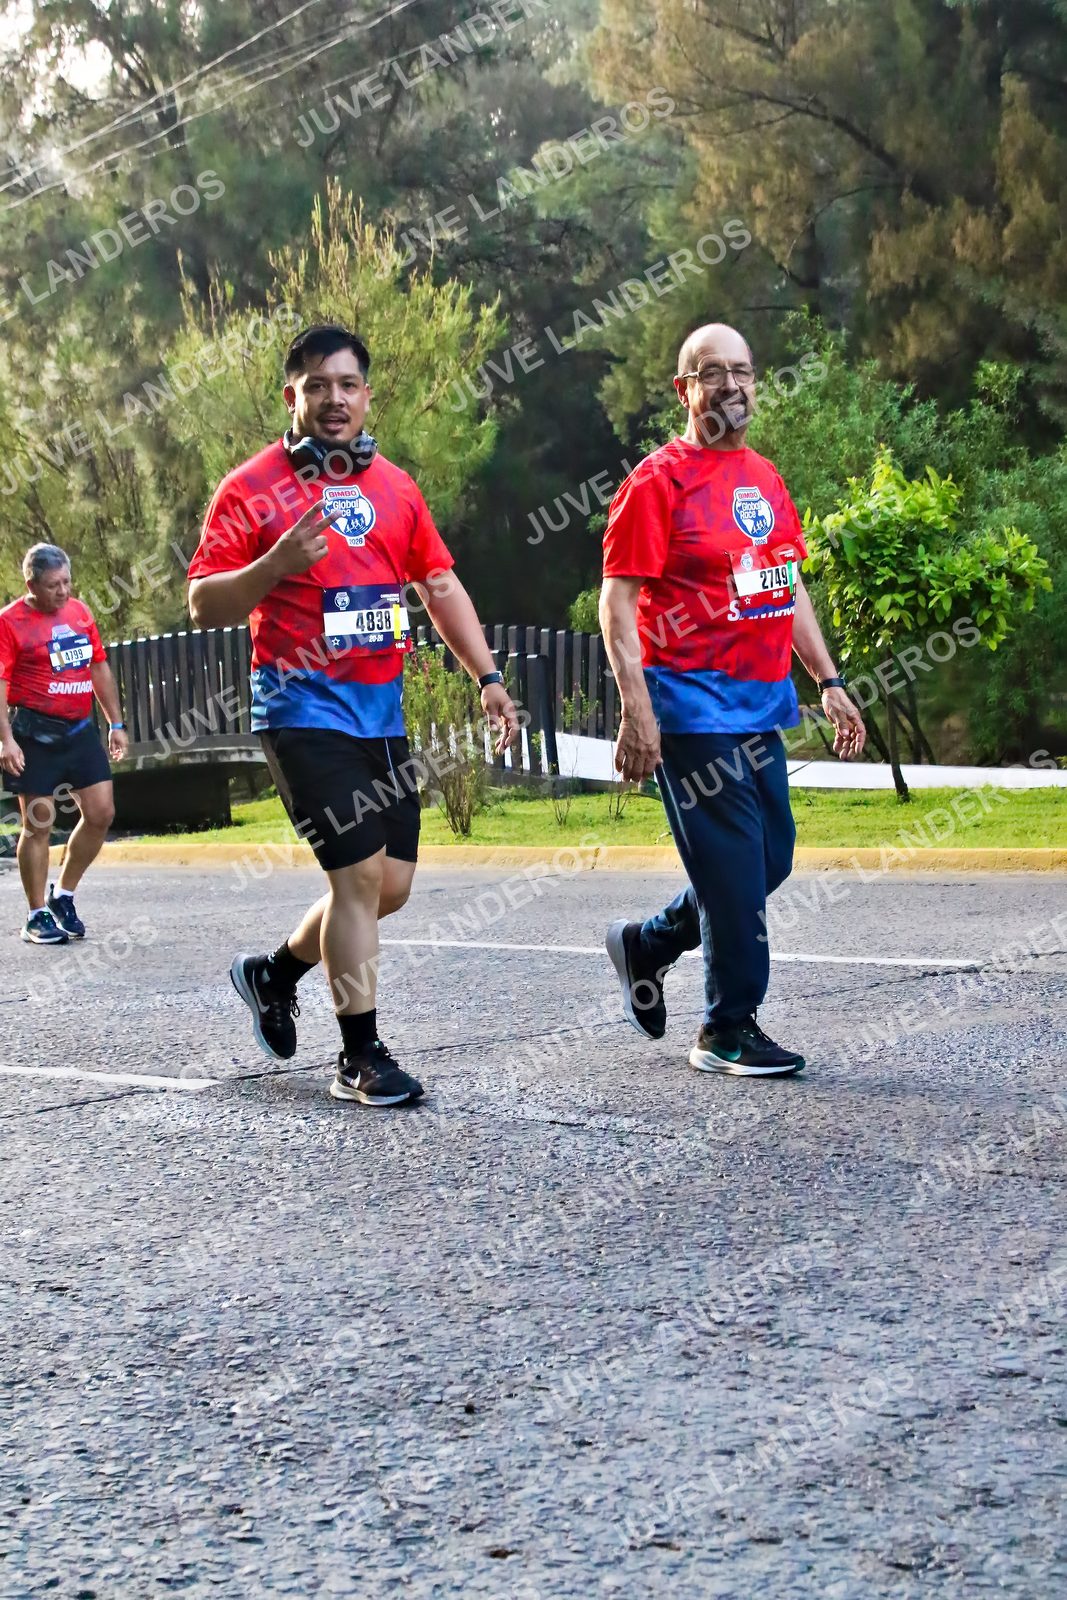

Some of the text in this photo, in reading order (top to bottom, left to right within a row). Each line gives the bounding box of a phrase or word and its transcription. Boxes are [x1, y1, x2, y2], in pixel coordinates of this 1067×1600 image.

[329, 490, 357, 498] BIMBO
[333, 500, 360, 510] Global
[740, 510, 757, 519] Race
[760, 566, 788, 590] 2749
[356, 610, 392, 632] 4838
[65, 648, 84, 662] 4799
